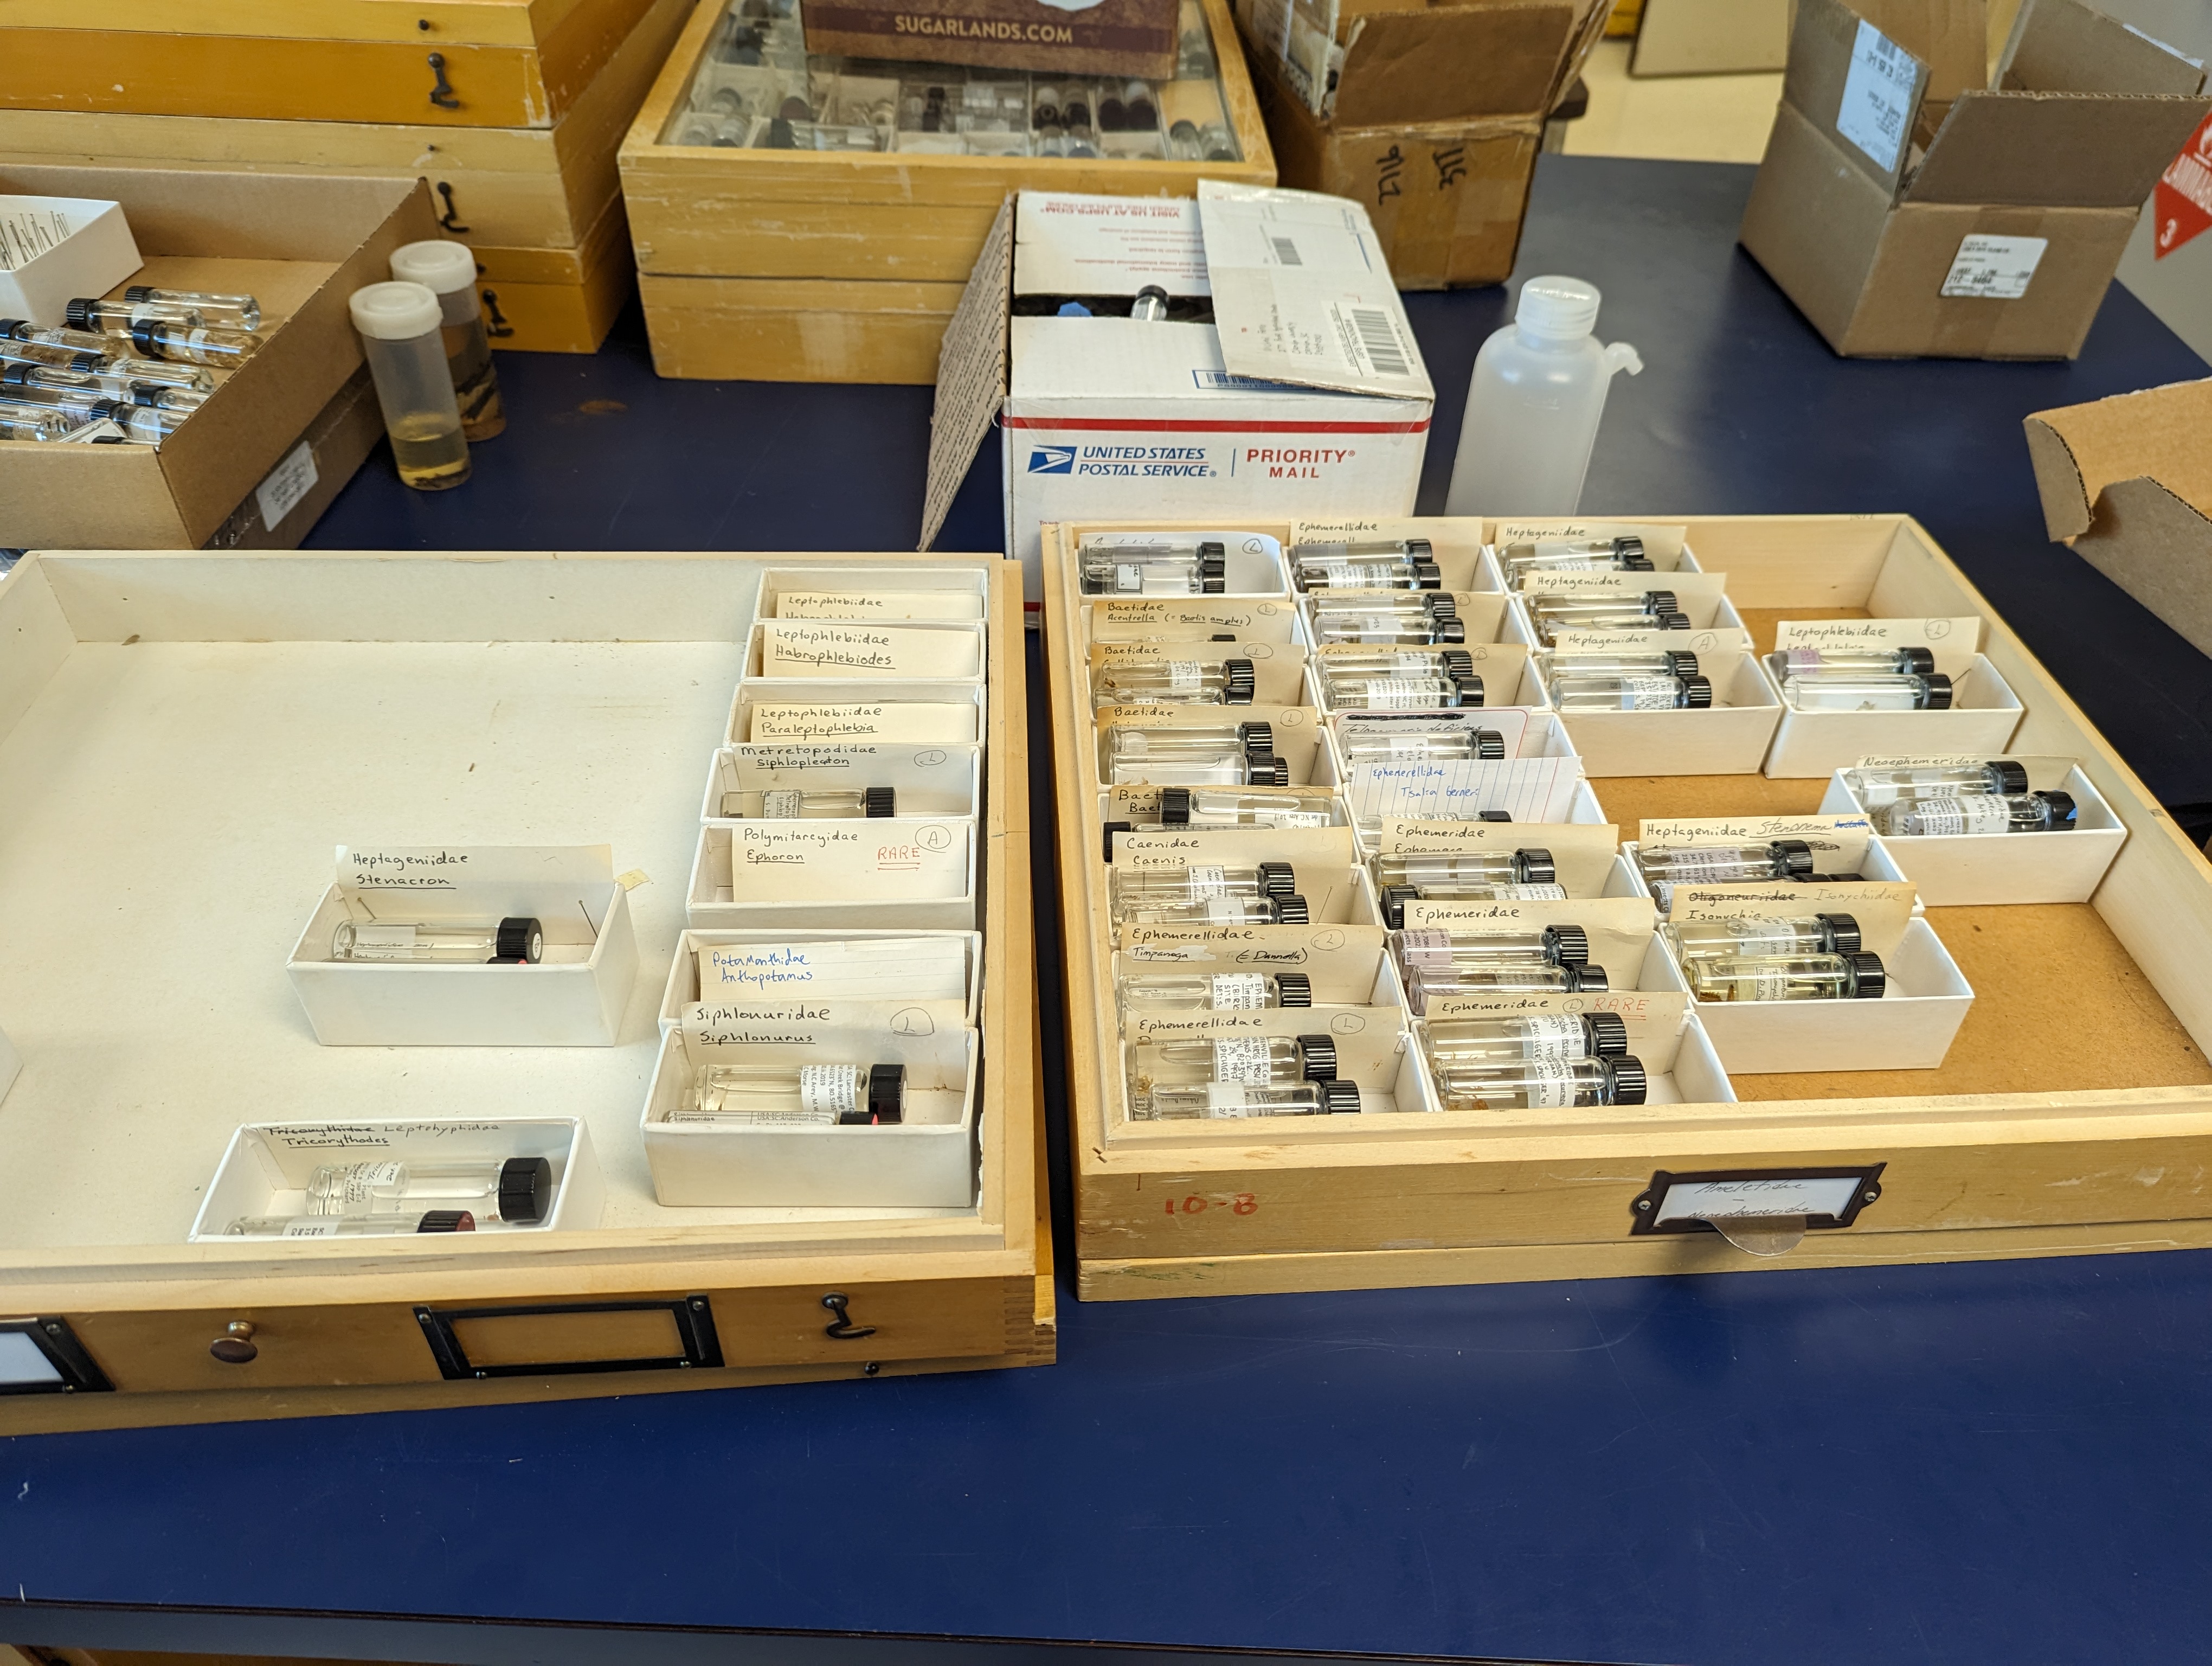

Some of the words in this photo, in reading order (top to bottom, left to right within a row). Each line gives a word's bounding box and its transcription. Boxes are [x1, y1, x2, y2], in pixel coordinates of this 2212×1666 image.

[895, 13, 1073, 44] SUGARLANDS.COM
[2160, 219, 2177, 248] 3
[1082, 447, 1146, 459] UNITED
[1148, 447, 1206, 459] STATES
[1078, 464, 1139, 476] POSTAL
[1269, 466, 1320, 478] MAIL
[1298, 522, 1378, 531] Ephemerellidae
[1506, 527, 1585, 539] Heptageniidae
[1537, 576, 1622, 591] Heptageniidae
[788, 596, 883, 608] Leptophlebiidae
[1107, 602, 1165, 611] Baetidae
[1107, 613, 1155, 622] Acentrella
[776, 628, 889, 646] Leptophlebiidae
[1568, 635, 1648, 649] Heptageniidae
[775, 644, 892, 667] Habrophlebiodes
[1104, 646, 1161, 655] Baetidae
[761, 707, 882, 721] Leptophlebiidae
[1114, 707, 1174, 717] Baetidae
[762, 722, 876, 741] Paraleptophlebia
[741, 745, 877, 757] Metretopodidae
[743, 827, 859, 848] Polymitarcyidae
[1396, 824, 1485, 838] Ephemeridae
[1646, 823, 1746, 841] Heptageniidae
[1127, 837, 1200, 849] Caenidae
[747, 849, 805, 863] Ephoron
[877, 845, 921, 861] RARE
[1133, 855, 1186, 865] Caenis
[352, 851, 469, 870] Heptageniidae
[356, 874, 450, 886] Stenacron
[1814, 888, 1902, 901] Isonychiidae
[1416, 906, 1520, 923] Ephemeridae
[1132, 928, 1255, 946] Ephemerellidae
[721, 968, 813, 990] Anthopotamus
[1441, 998, 1549, 1014] Ephemeridae
[1593, 998, 1650, 1012] RARE
[696, 1004, 831, 1026] Siphlonuridae
[1139, 1017, 1263, 1034] Ephemerellidae
[699, 1030, 813, 1047] Siphlonurus
[282, 1134, 389, 1147] Tricorythodes
[1164, 1193, 1258, 1216] 10-8
